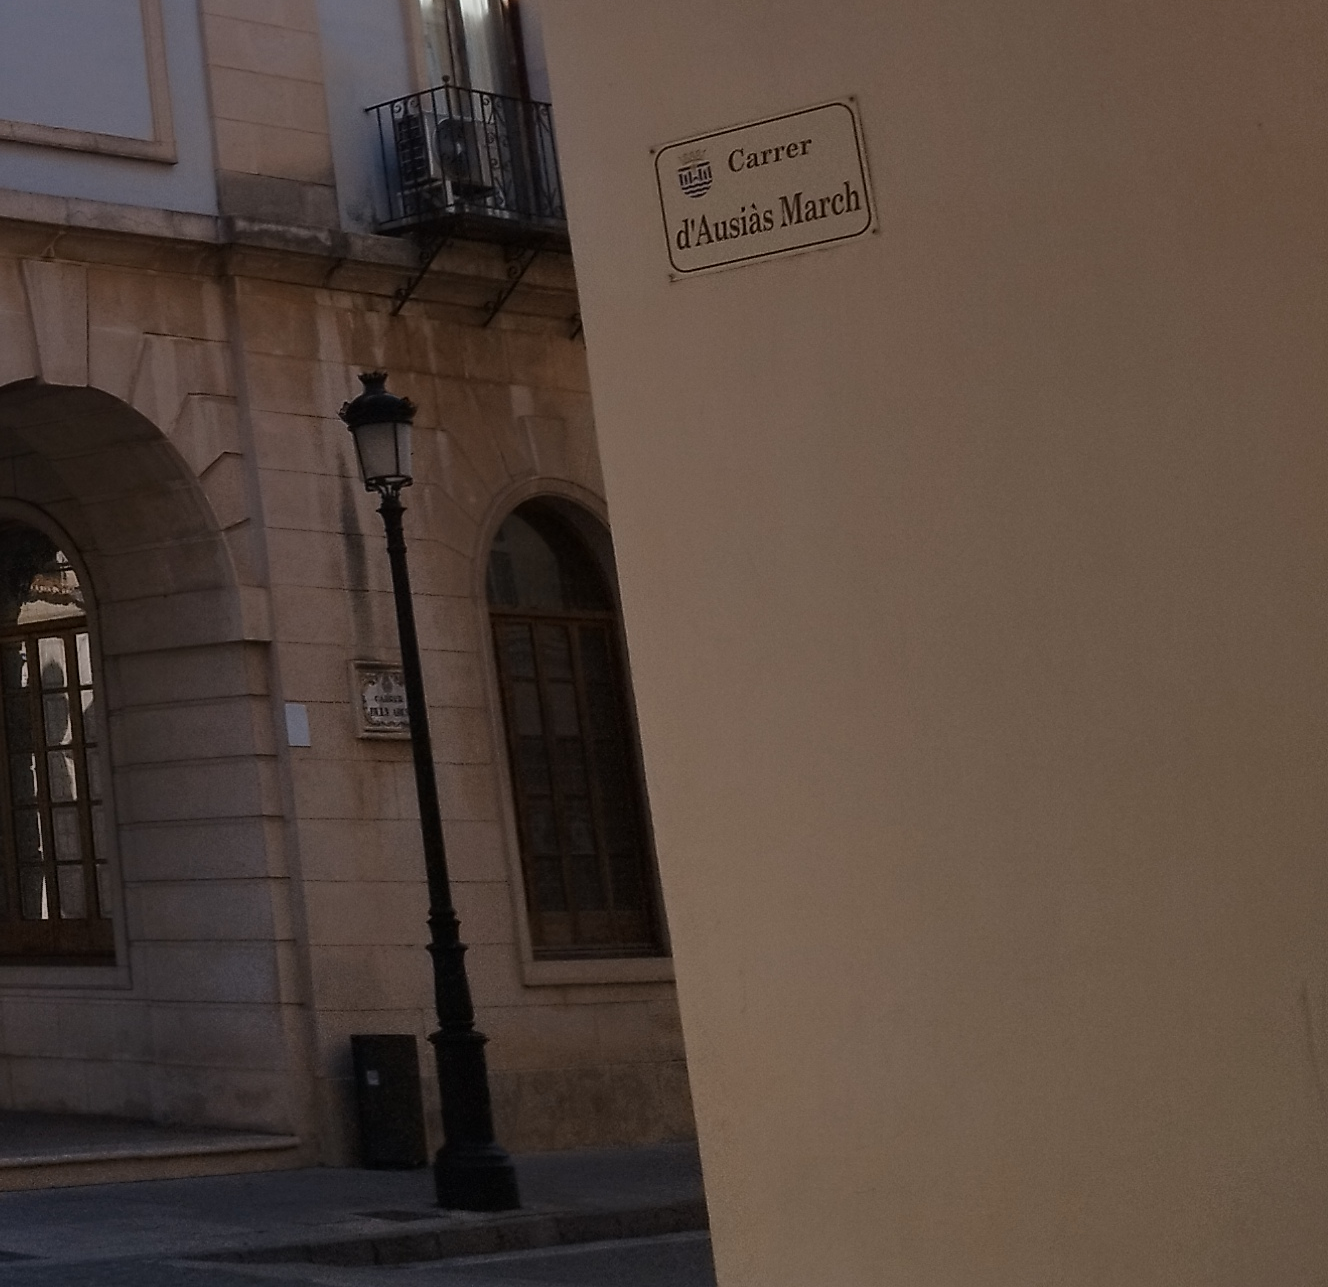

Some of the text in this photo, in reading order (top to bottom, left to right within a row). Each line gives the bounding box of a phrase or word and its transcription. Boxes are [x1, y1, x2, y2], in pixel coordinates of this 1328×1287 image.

[727, 137, 812, 172] Carrer
[676, 180, 862, 250] d'Ausiàs March
